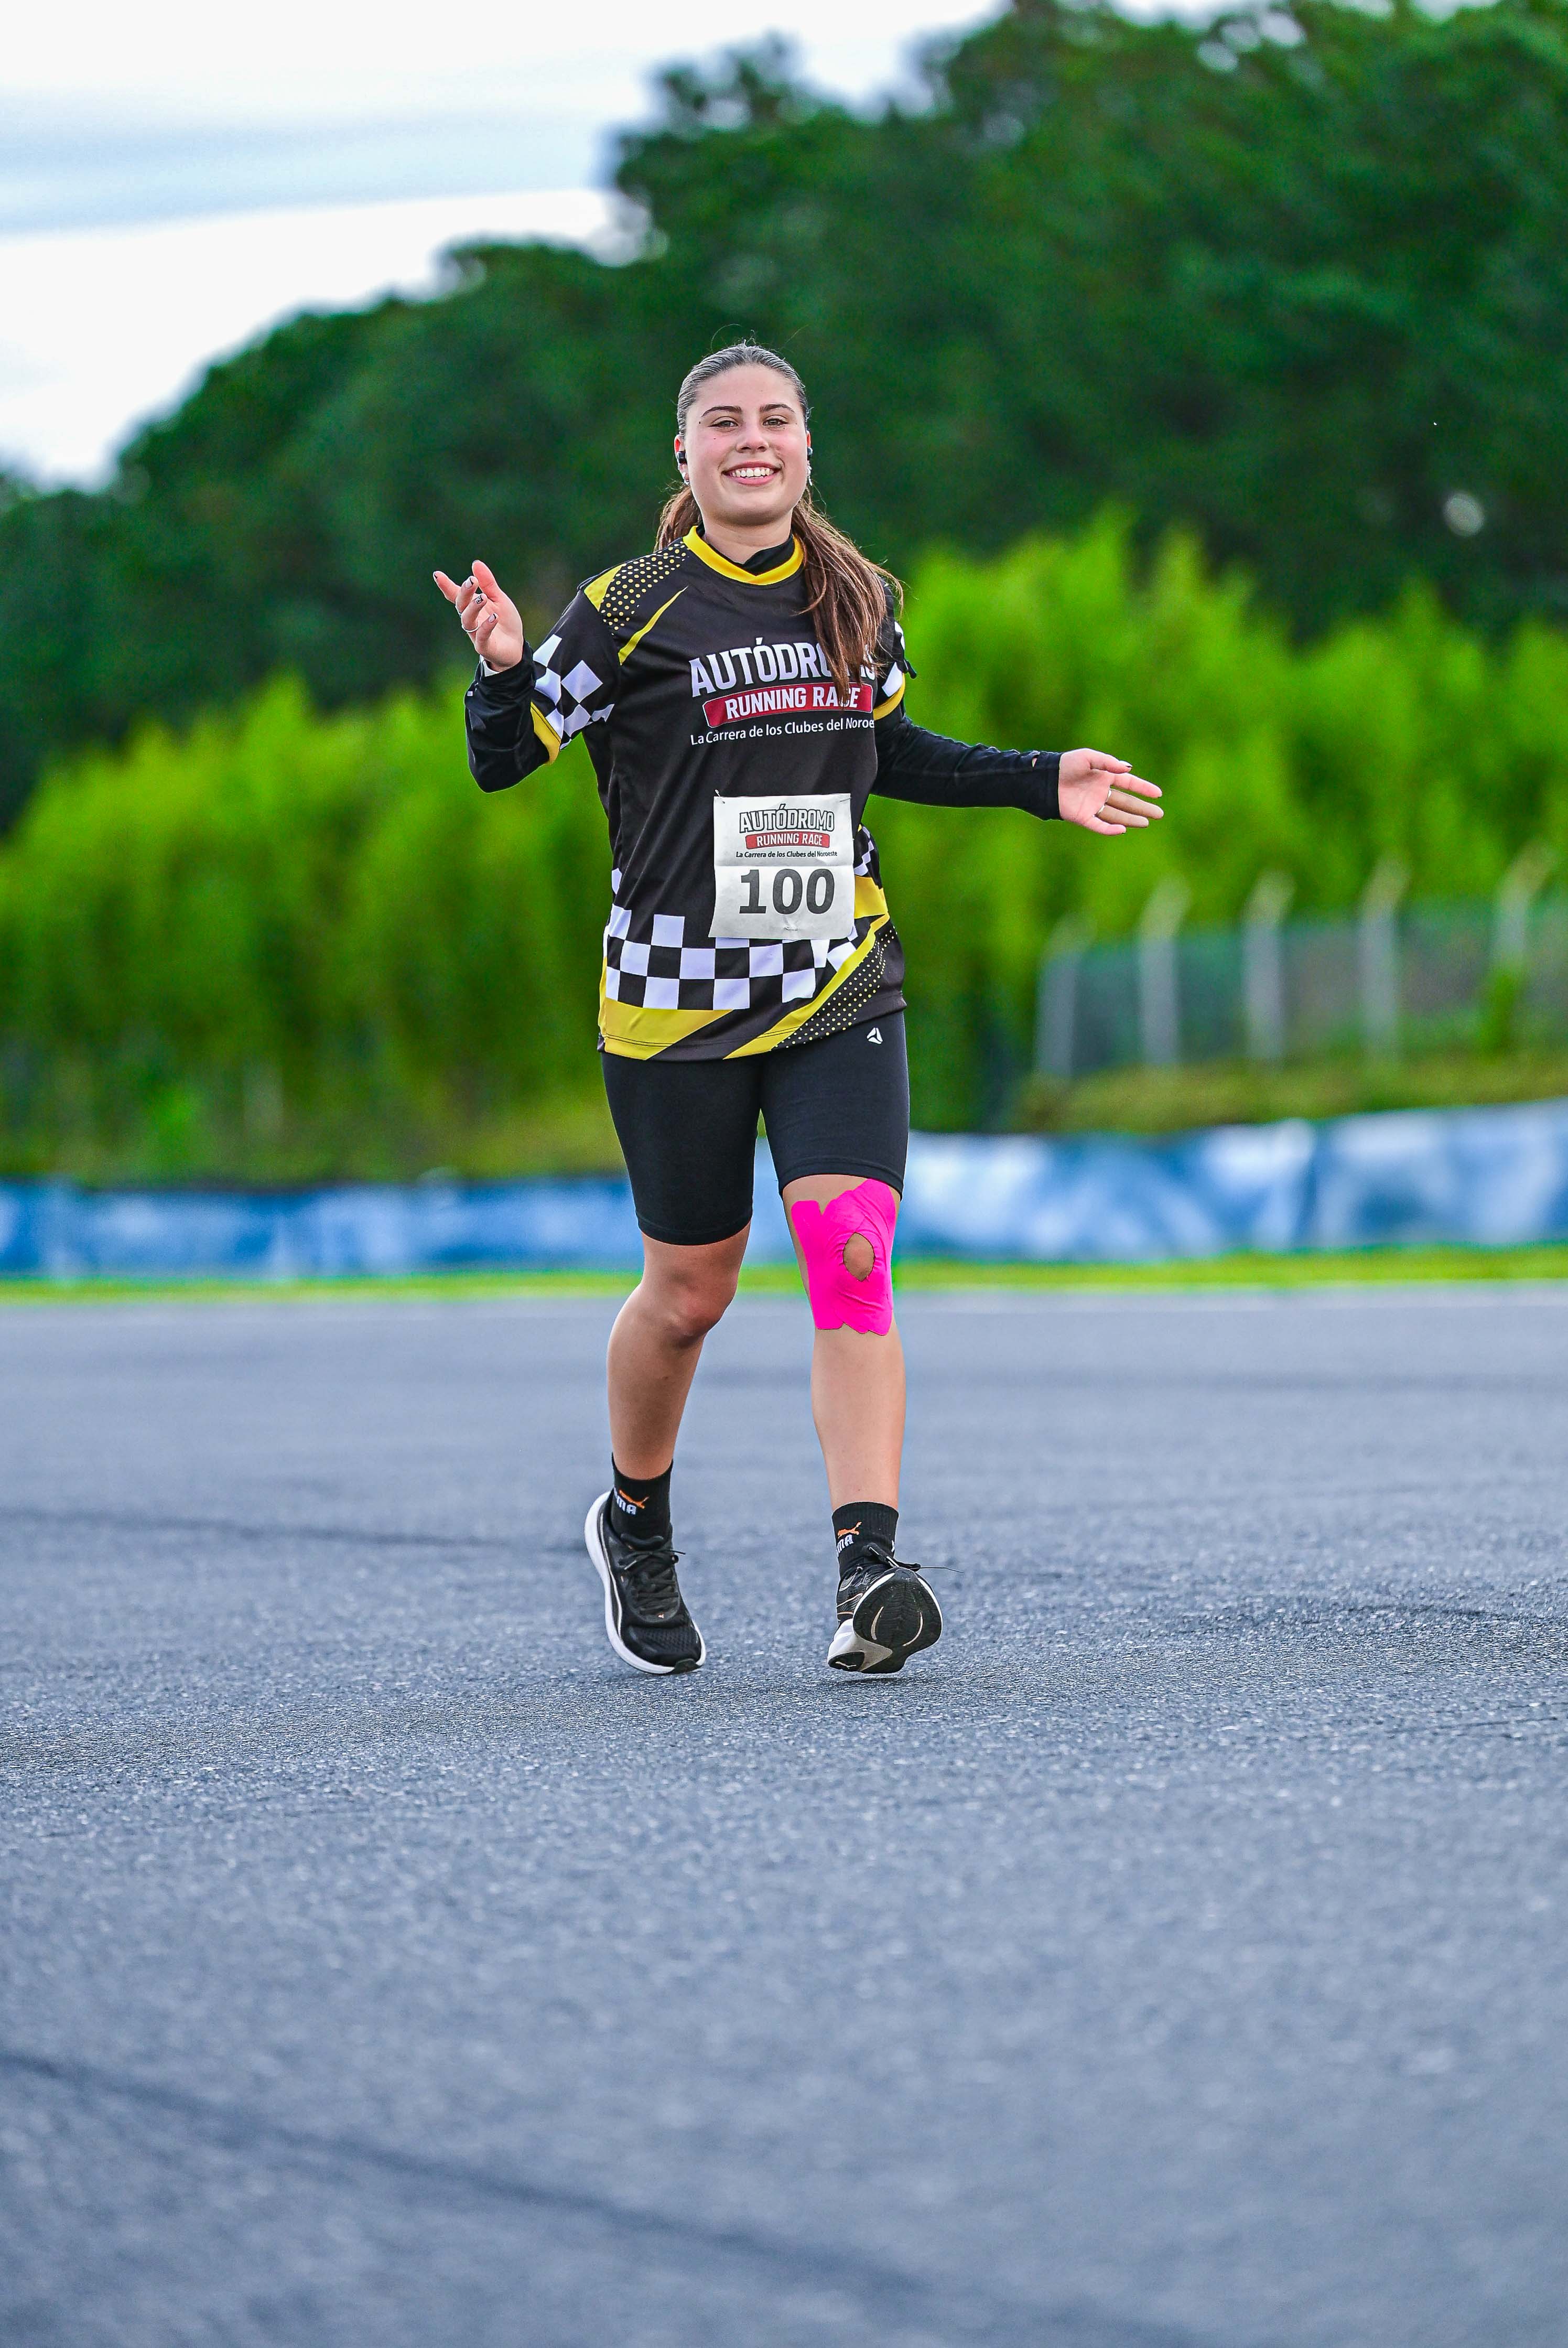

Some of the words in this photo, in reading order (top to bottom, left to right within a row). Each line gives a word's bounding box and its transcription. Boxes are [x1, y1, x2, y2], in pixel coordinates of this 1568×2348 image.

[688, 637, 875, 697] AUTÓDRO
[724, 686, 806, 720] RUNNING
[690, 734, 704, 746] La
[706, 729, 746, 743] Carrera
[749, 725, 763, 737] de
[766, 724, 782, 736] los
[784, 721, 824, 734] Clubes
[826, 718, 844, 730] del
[846, 717, 875, 729] Noroe
[739, 803, 835, 833] AUTÓDROMO
[756, 833, 799, 847] RUNNING
[802, 833, 823, 846] RACE
[739, 868, 835, 914] 100
